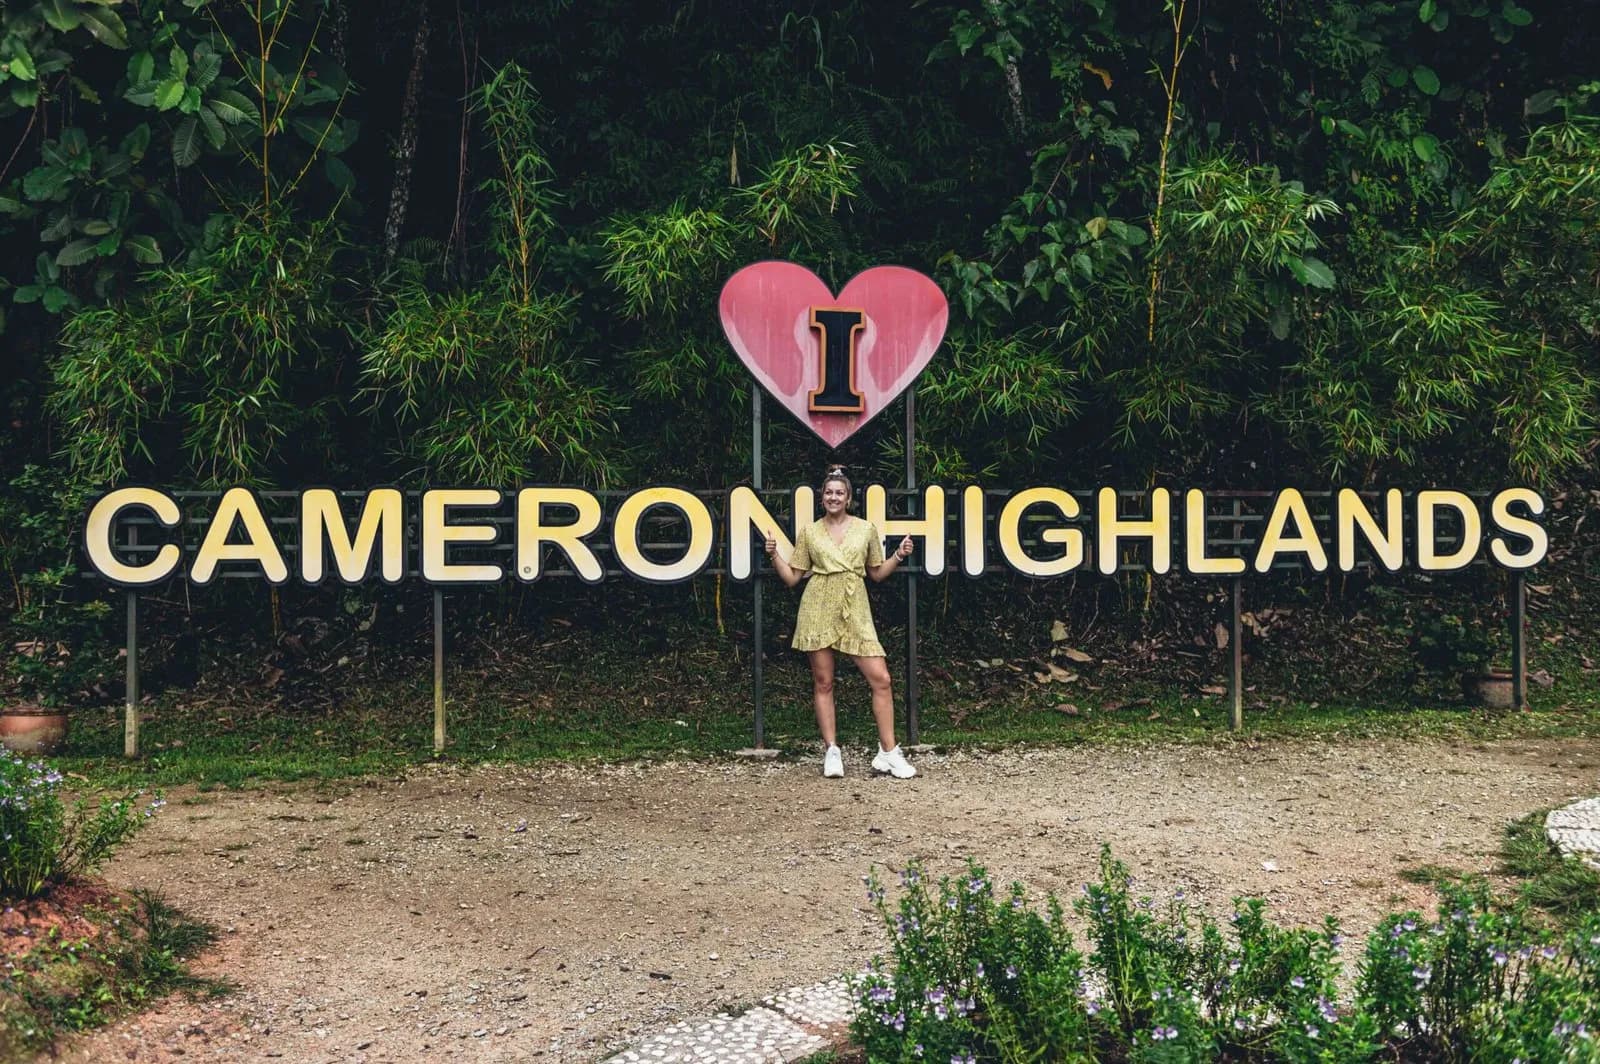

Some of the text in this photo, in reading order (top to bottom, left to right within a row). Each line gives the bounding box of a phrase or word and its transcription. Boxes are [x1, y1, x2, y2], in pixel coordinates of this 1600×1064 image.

[808, 306, 866, 412] I
[84, 484, 1549, 585] CAMERON HIGHLANDS
